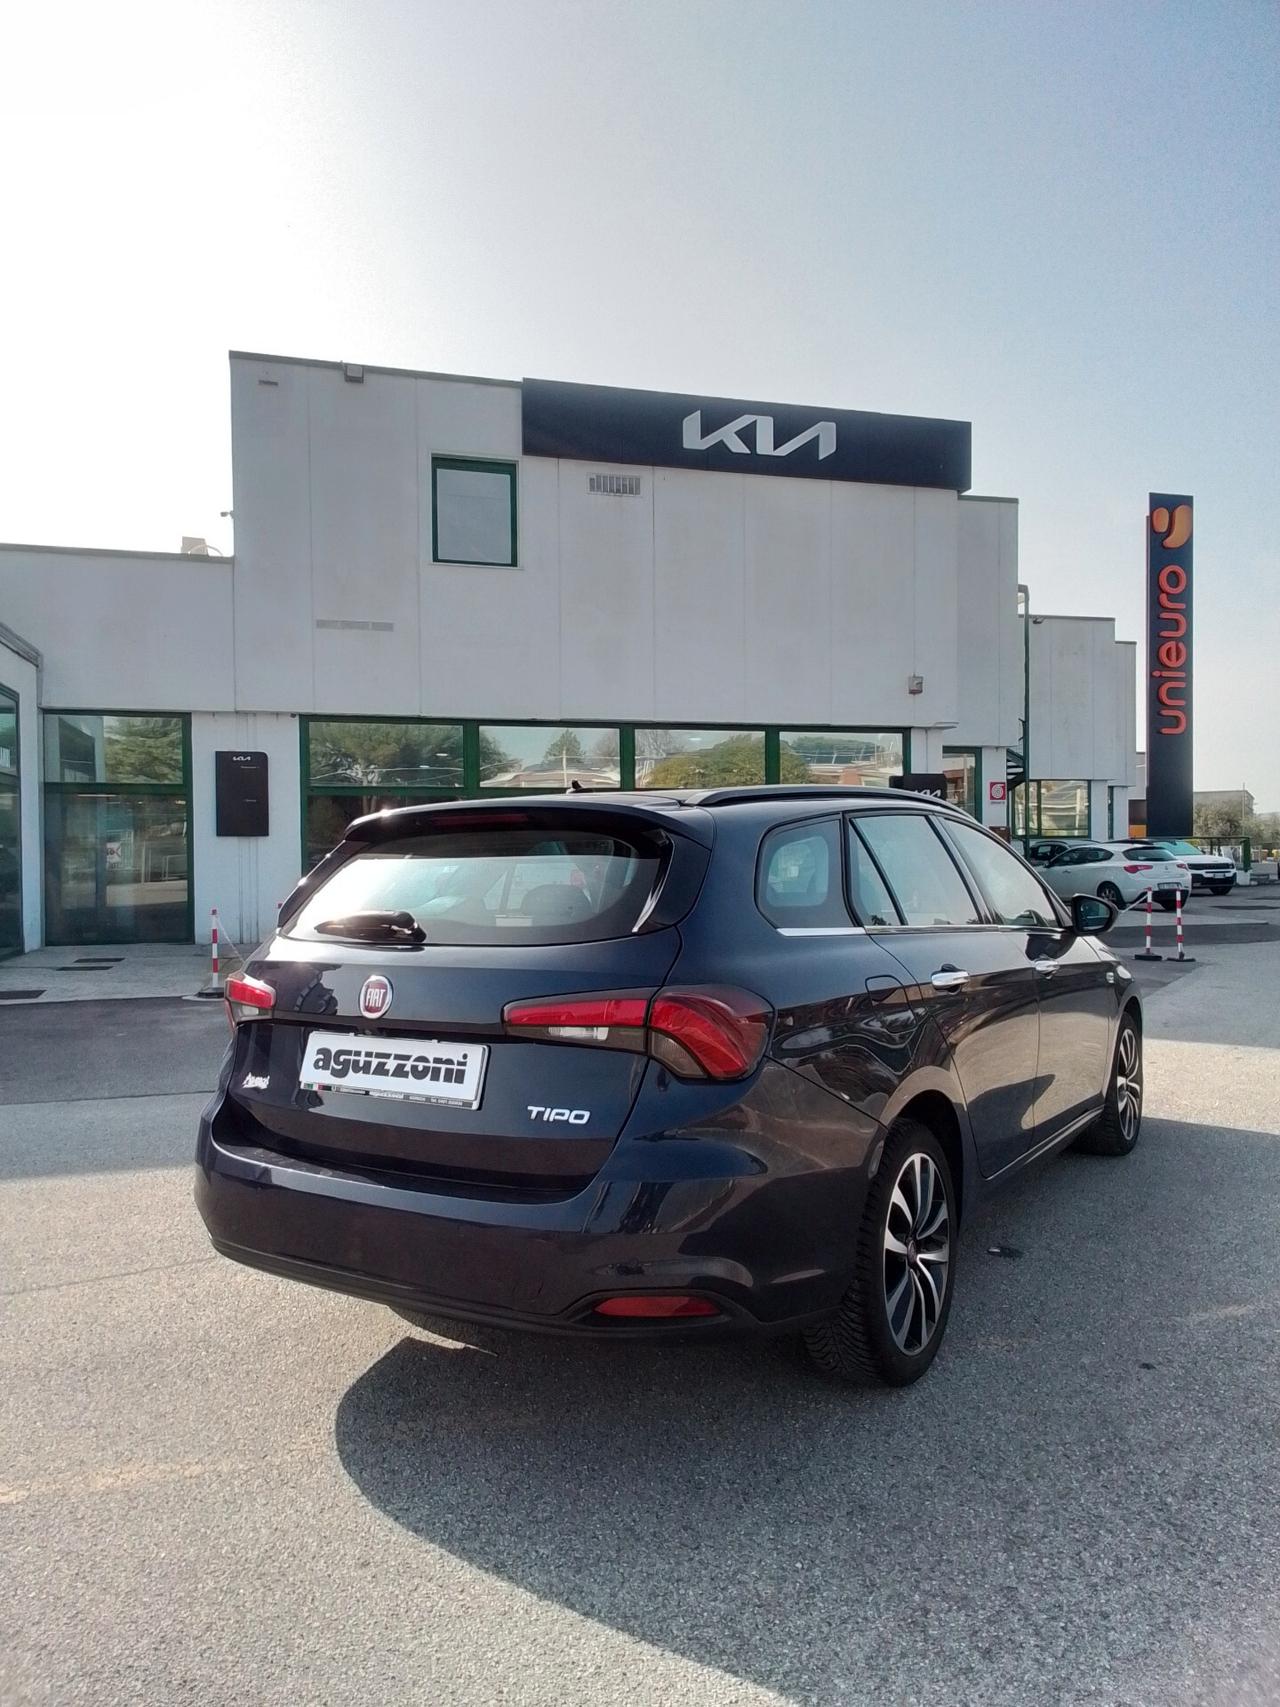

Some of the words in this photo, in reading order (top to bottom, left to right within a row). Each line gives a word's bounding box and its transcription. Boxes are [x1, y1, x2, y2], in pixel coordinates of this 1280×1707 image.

[682, 409, 837, 461] KIA
[1152, 564, 1187, 735] unieuro
[365, 988, 387, 1008] FIAT
[313, 1047, 469, 1084] aguzzoni
[527, 1105, 592, 1126] TIPO
